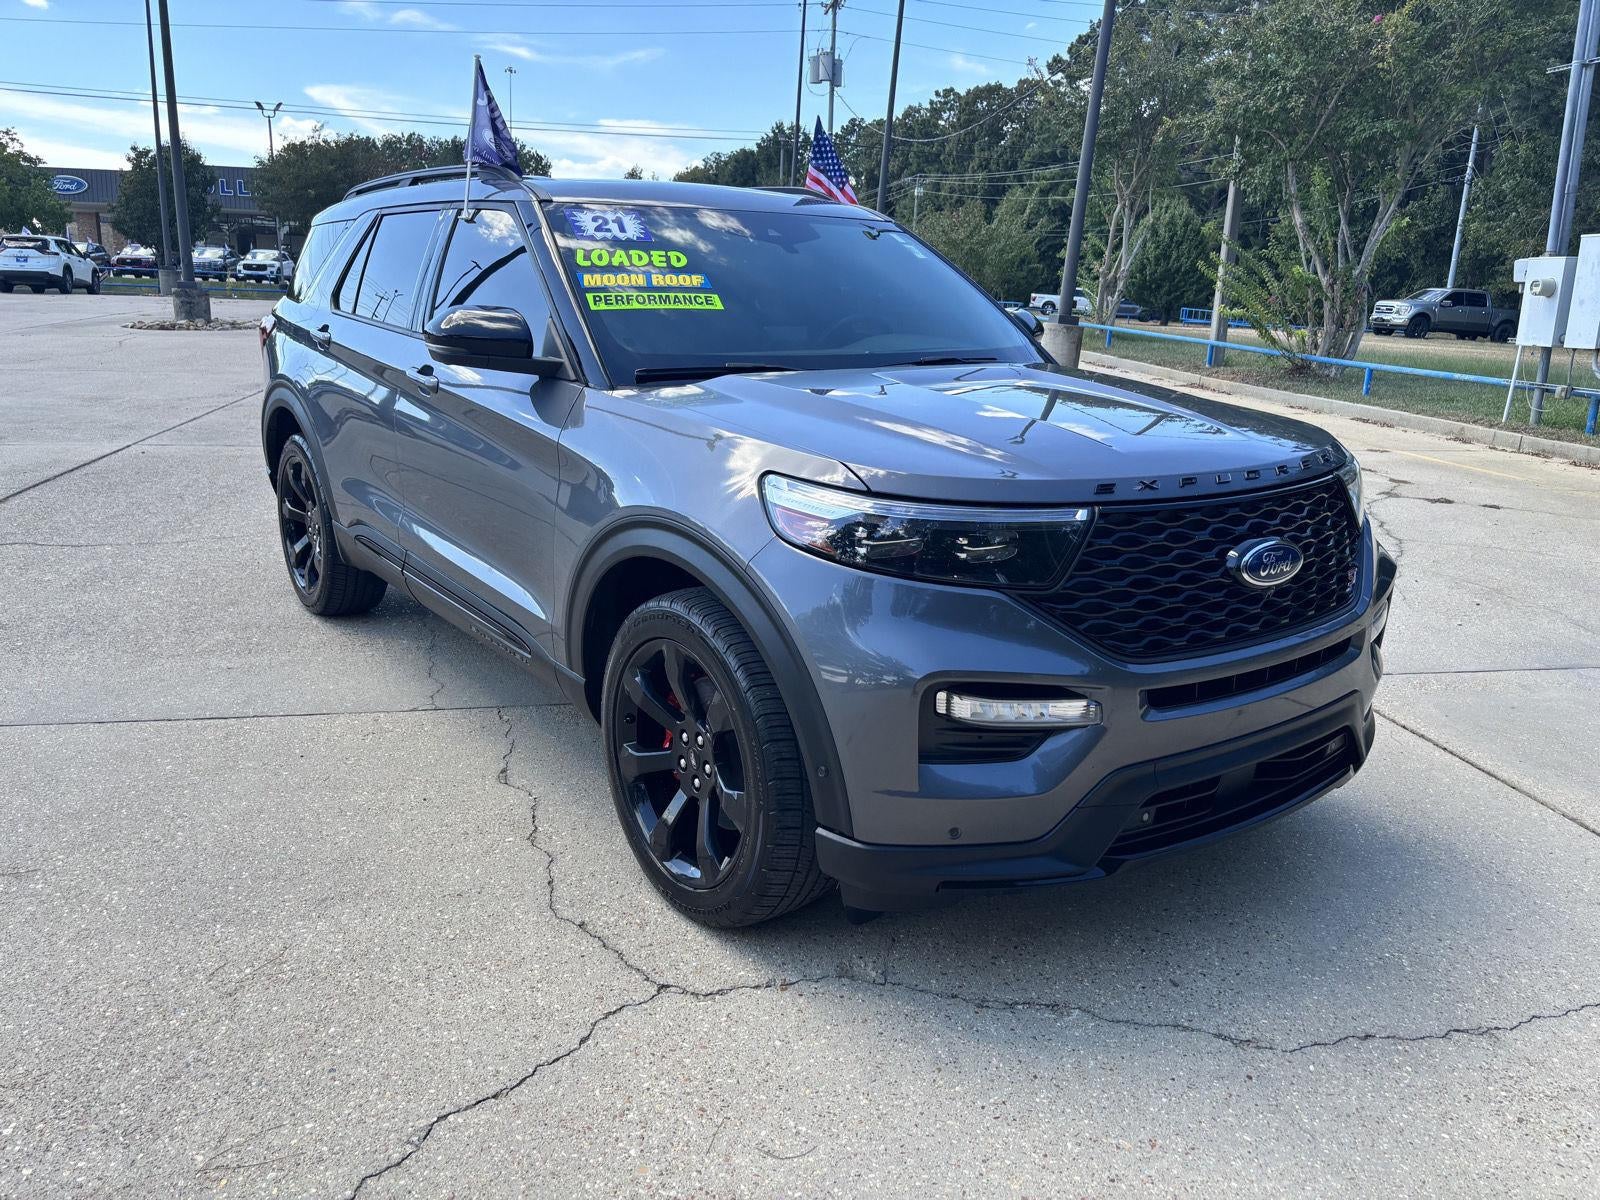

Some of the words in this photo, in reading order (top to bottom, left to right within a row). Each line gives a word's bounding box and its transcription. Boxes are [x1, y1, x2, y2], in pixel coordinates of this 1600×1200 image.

[53, 178, 78, 191] Ford
[592, 215, 627, 233] 21
[577, 249, 687, 267] LOADED
[583, 274, 645, 286] MOON
[651, 274, 705, 287] ROOF
[593, 295, 714, 306] PERFORMANCE
[1093, 447, 1334, 495] EXPLORER
[1260, 551, 1293, 576] Ford
